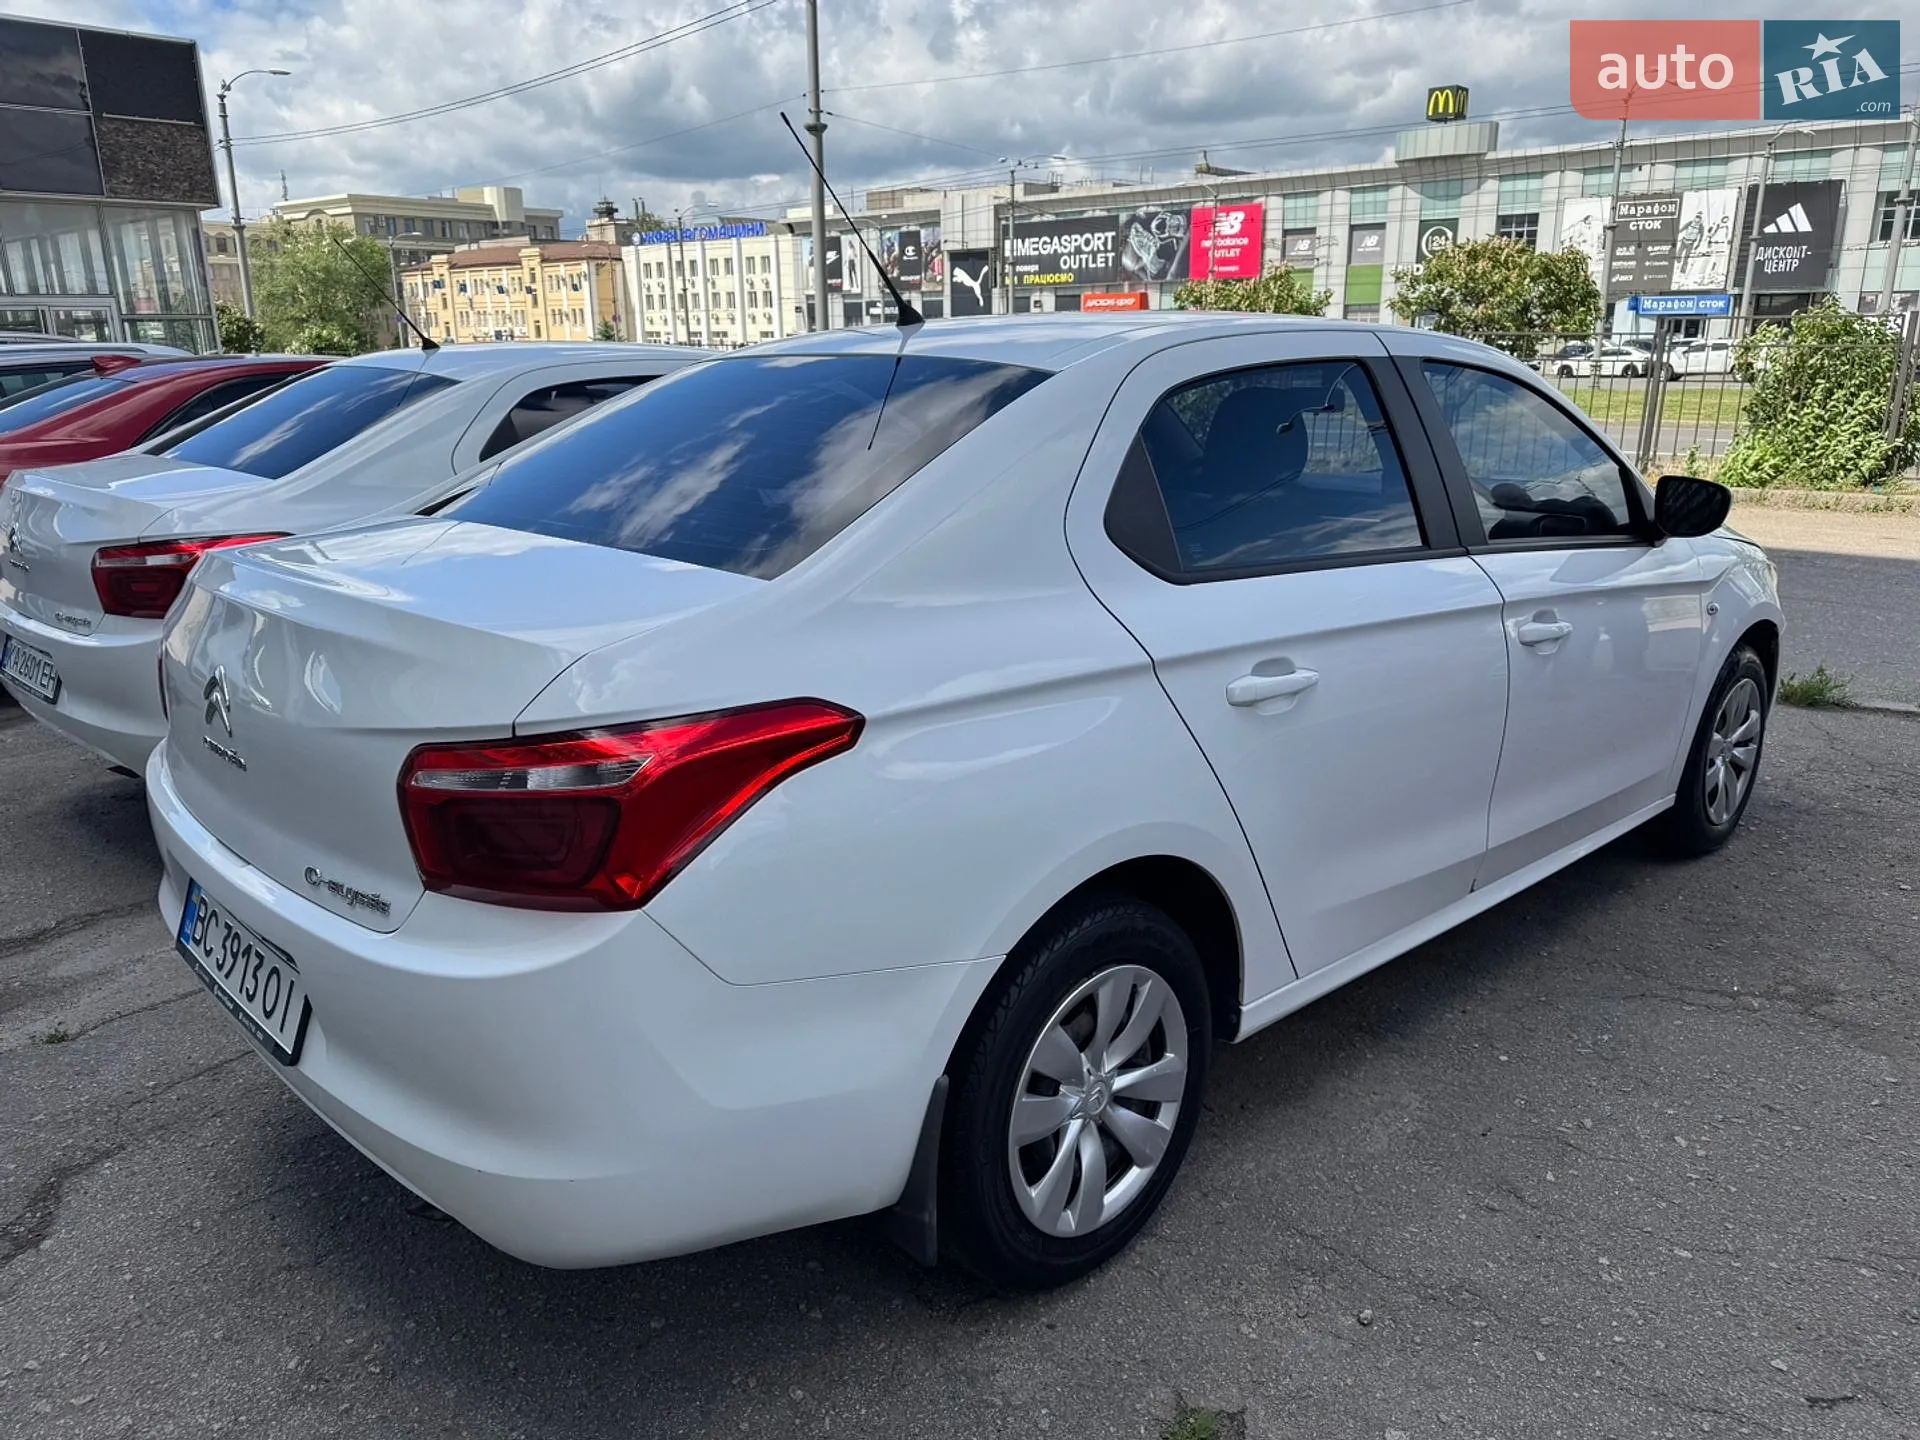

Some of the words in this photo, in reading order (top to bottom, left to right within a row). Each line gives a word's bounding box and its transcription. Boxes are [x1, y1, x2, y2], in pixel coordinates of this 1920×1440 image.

[1060, 252, 1116, 270] OUTLET
[1208, 248, 1241, 258] UTLET
[1764, 259, 1799, 274] ЦЕНТР
[191, 894, 219, 958] BC
[216, 921, 266, 1003] 3913
